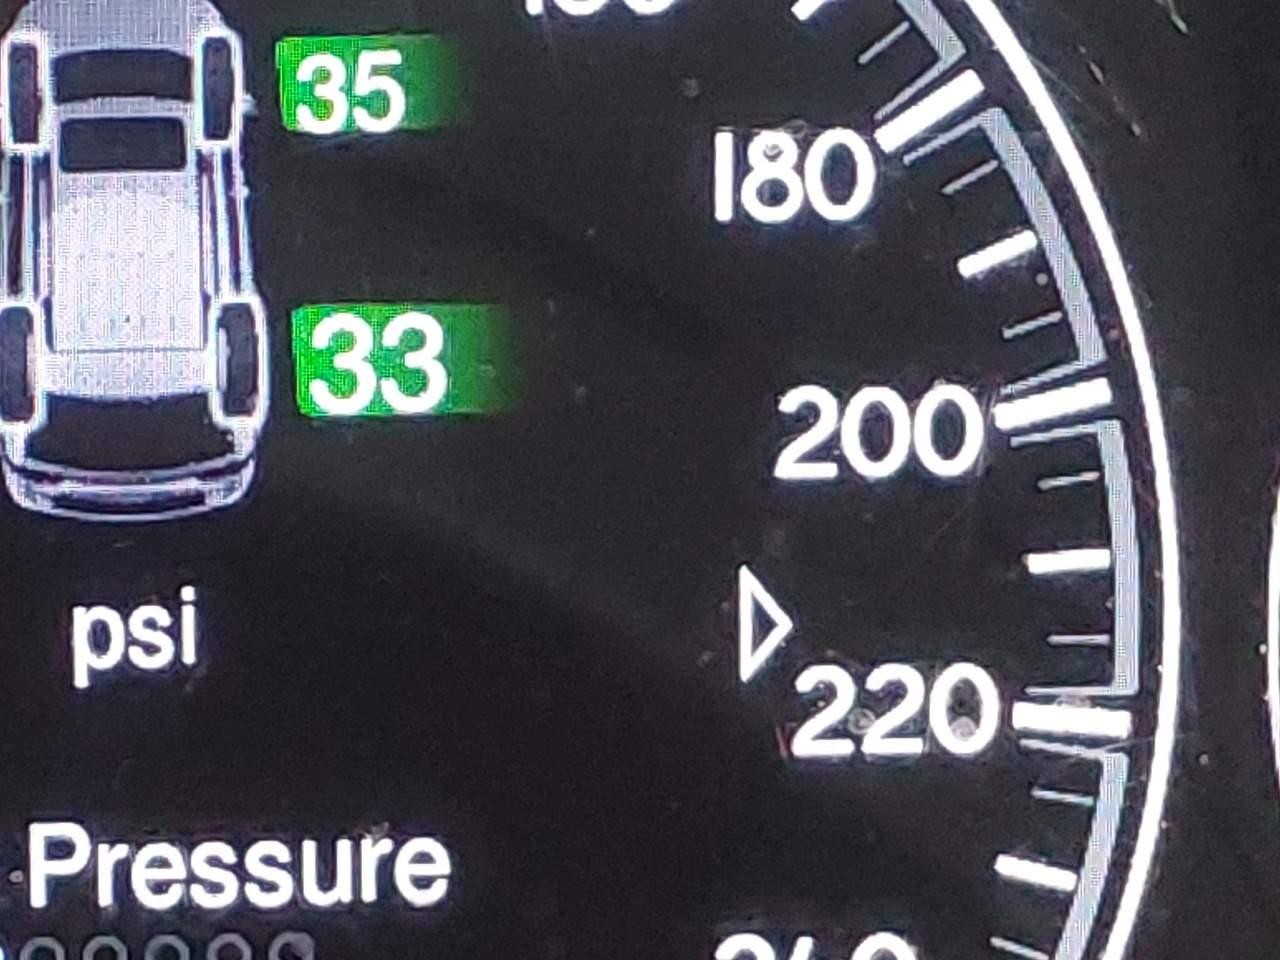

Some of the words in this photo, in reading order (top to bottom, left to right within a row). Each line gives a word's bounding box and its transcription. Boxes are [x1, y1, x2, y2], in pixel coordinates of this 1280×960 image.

[296, 50, 406, 134] 35
[714, 127, 877, 223] 180
[309, 311, 448, 416] 33
[773, 384, 985, 480] 200
[71, 585, 197, 689] psi
[791, 662, 1001, 757] 220
[28, 821, 452, 910] Pressure
